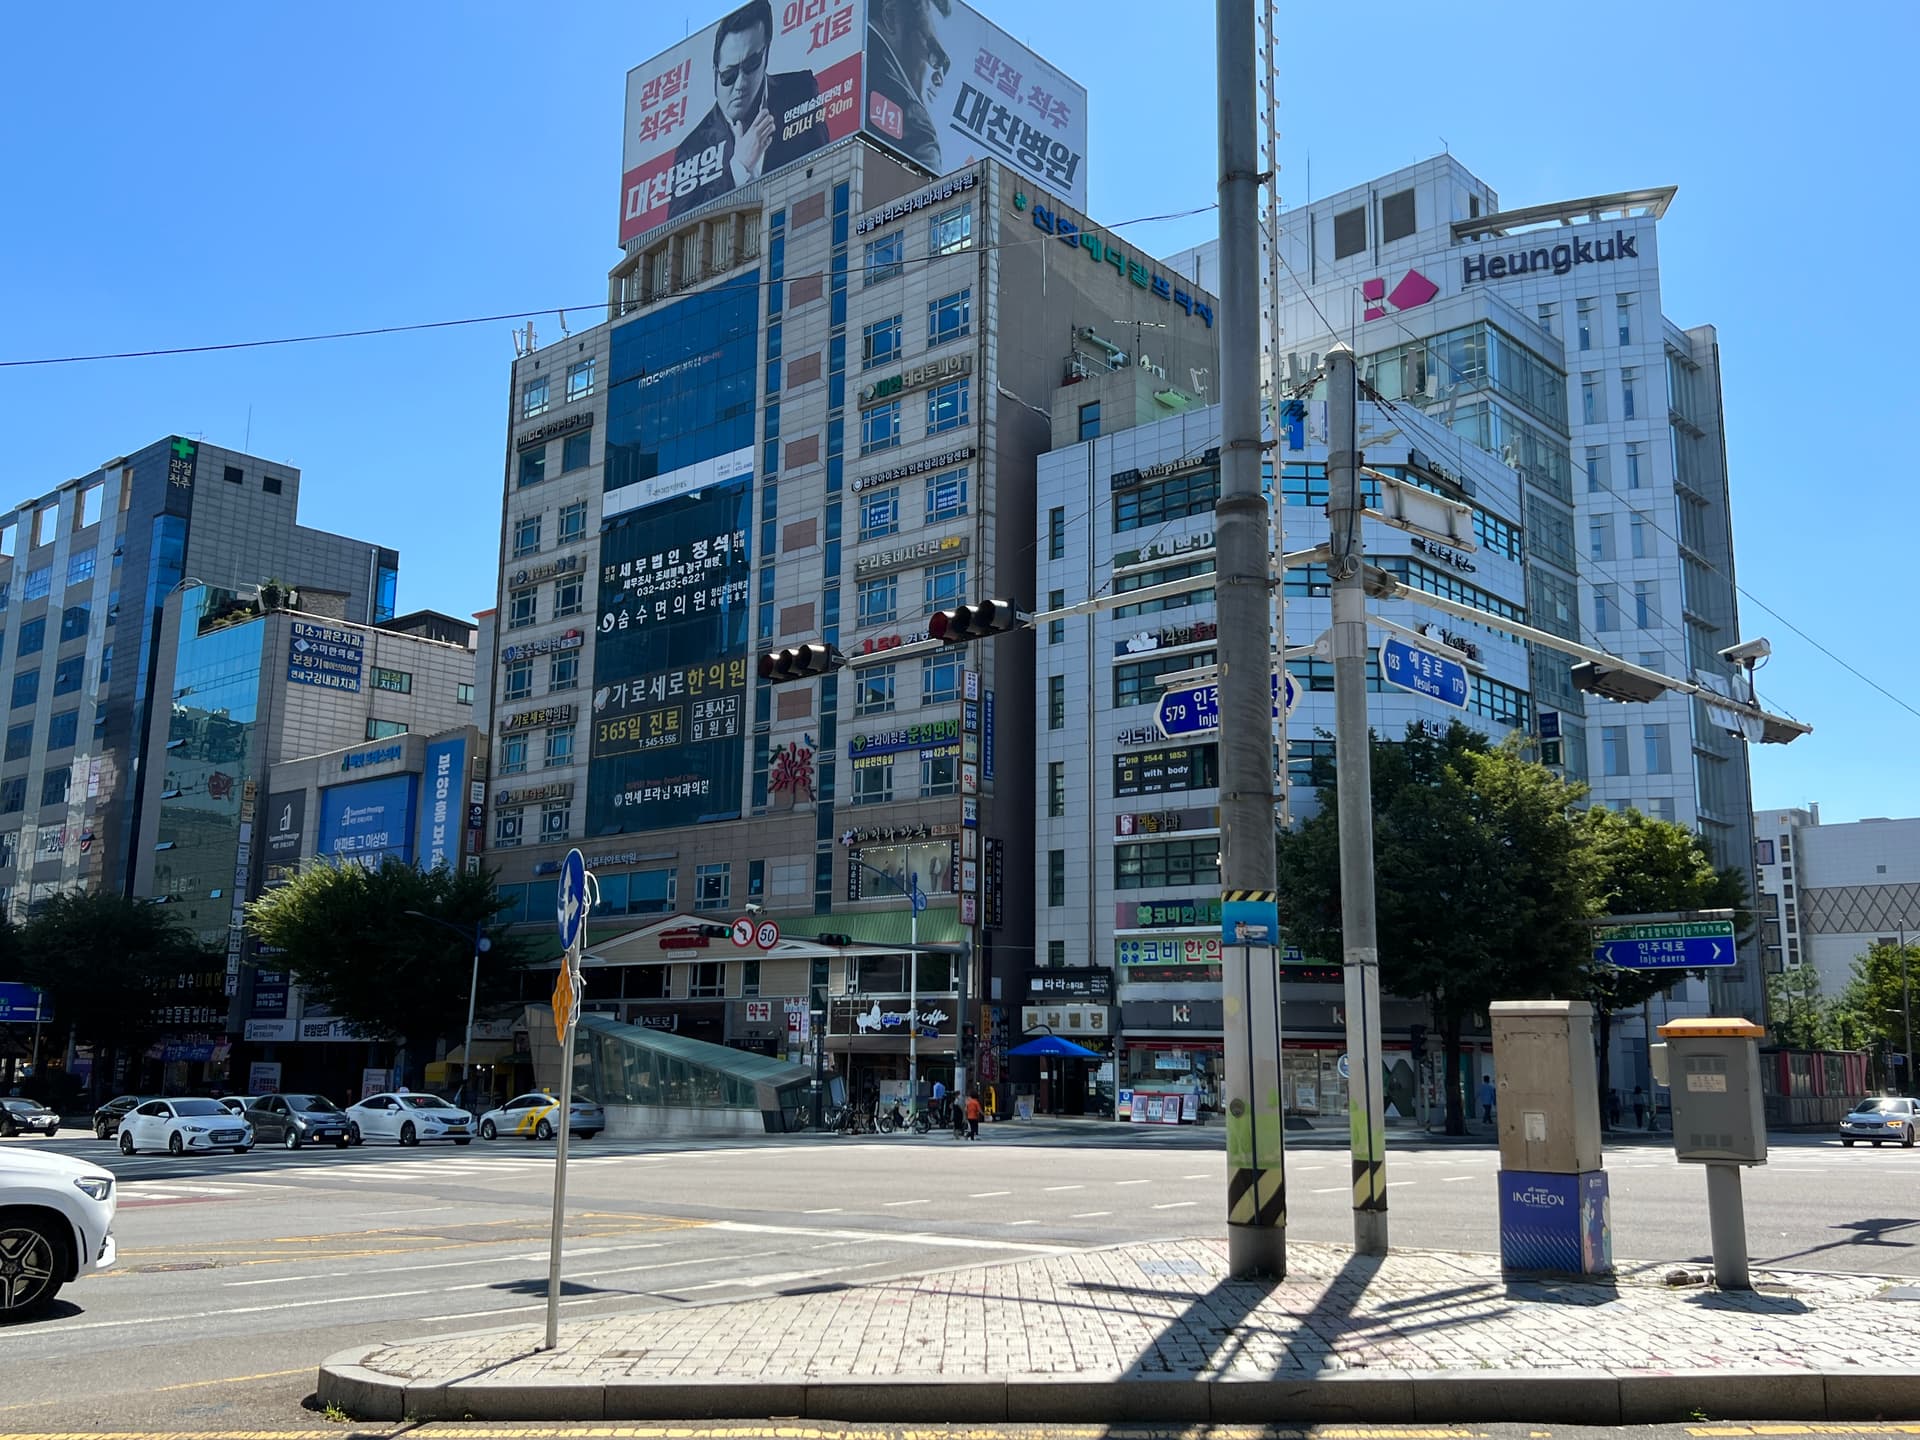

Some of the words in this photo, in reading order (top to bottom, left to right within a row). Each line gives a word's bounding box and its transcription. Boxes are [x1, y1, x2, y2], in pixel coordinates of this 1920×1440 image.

[806, 3, 855, 55] 치료
[640, 58, 692, 112] 관절!
[1027, 84, 1071, 130] 척추
[639, 95, 688, 144] 척추!
[782, 113, 813, 141] 여기서
[815, 106, 826, 122] 약
[828, 97, 853, 119] 30m
[952, 81, 1081, 191] 대찬병원
[625, 139, 727, 222] 대찬병원
[1462, 229, 1639, 284] Heungkuk
[619, 549, 680, 577] 세무법인
[692, 534, 729, 560] 정석
[858, 538, 940, 572] 우리동네사진관
[636, 572, 706, 597] 032-433-6221
[617, 590, 706, 630] 숨수면의원
[1387, 652, 1400, 671] 183
[1408, 649, 1445, 679] 예술로
[611, 658, 746, 709] 가로세로한의원
[1413, 674, 1441, 697] Yesul-ro
[1452, 677, 1465, 696] 179
[694, 699, 736, 719] 교통사고
[1165, 705, 1186, 722] 579
[1198, 713, 1218, 727] Inju
[599, 715, 641, 742] 365일
[650, 710, 679, 736] 진료
[693, 717, 736, 740] 입원실
[907, 719, 960, 745] 운전면허
[1143, 768, 1163, 778] with
[1167, 765, 1189, 776] body
[624, 788, 642, 807] 연세
[333, 837, 357, 851] 아파트
[356, 836, 365, 848] 그
[366, 831, 389, 848] 이상의
[759, 929, 775, 943] 50
[1143, 939, 1223, 963] 코비한의
[1638, 940, 1687, 956] 인주대로
[1639, 954, 1687, 965] Inju-daero
[748, 1003, 769, 1020] 약국
[921, 1008, 950, 1026] coffee
[1172, 1004, 1191, 1023] kt
[1332, 1006, 1345, 1024] k
[1512, 1191, 1565, 1206] INCHEON
